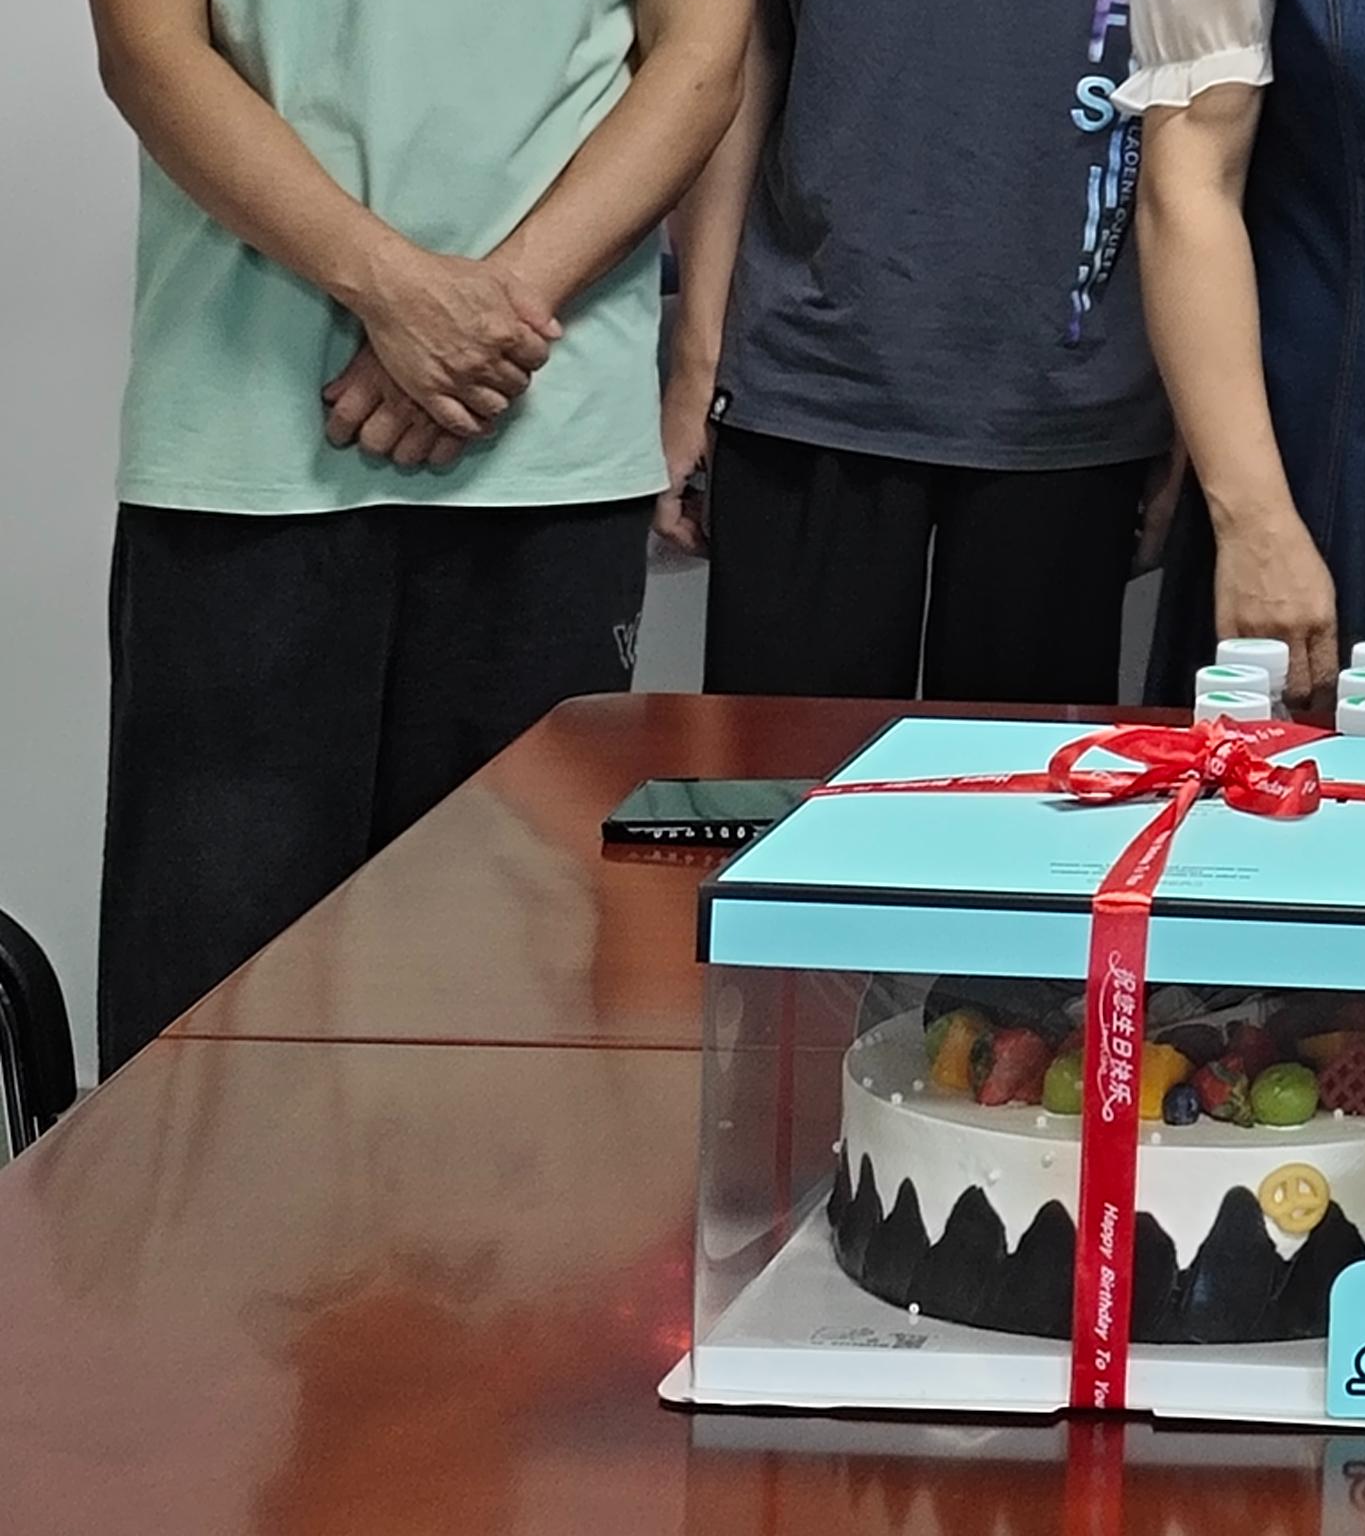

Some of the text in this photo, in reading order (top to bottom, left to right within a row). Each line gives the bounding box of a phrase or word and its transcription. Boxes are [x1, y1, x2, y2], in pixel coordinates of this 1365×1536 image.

[1098, 1201, 1119, 1260] Happy
[1093, 1265, 1116, 1341] Birthday
[1094, 1349, 1111, 1372] To
